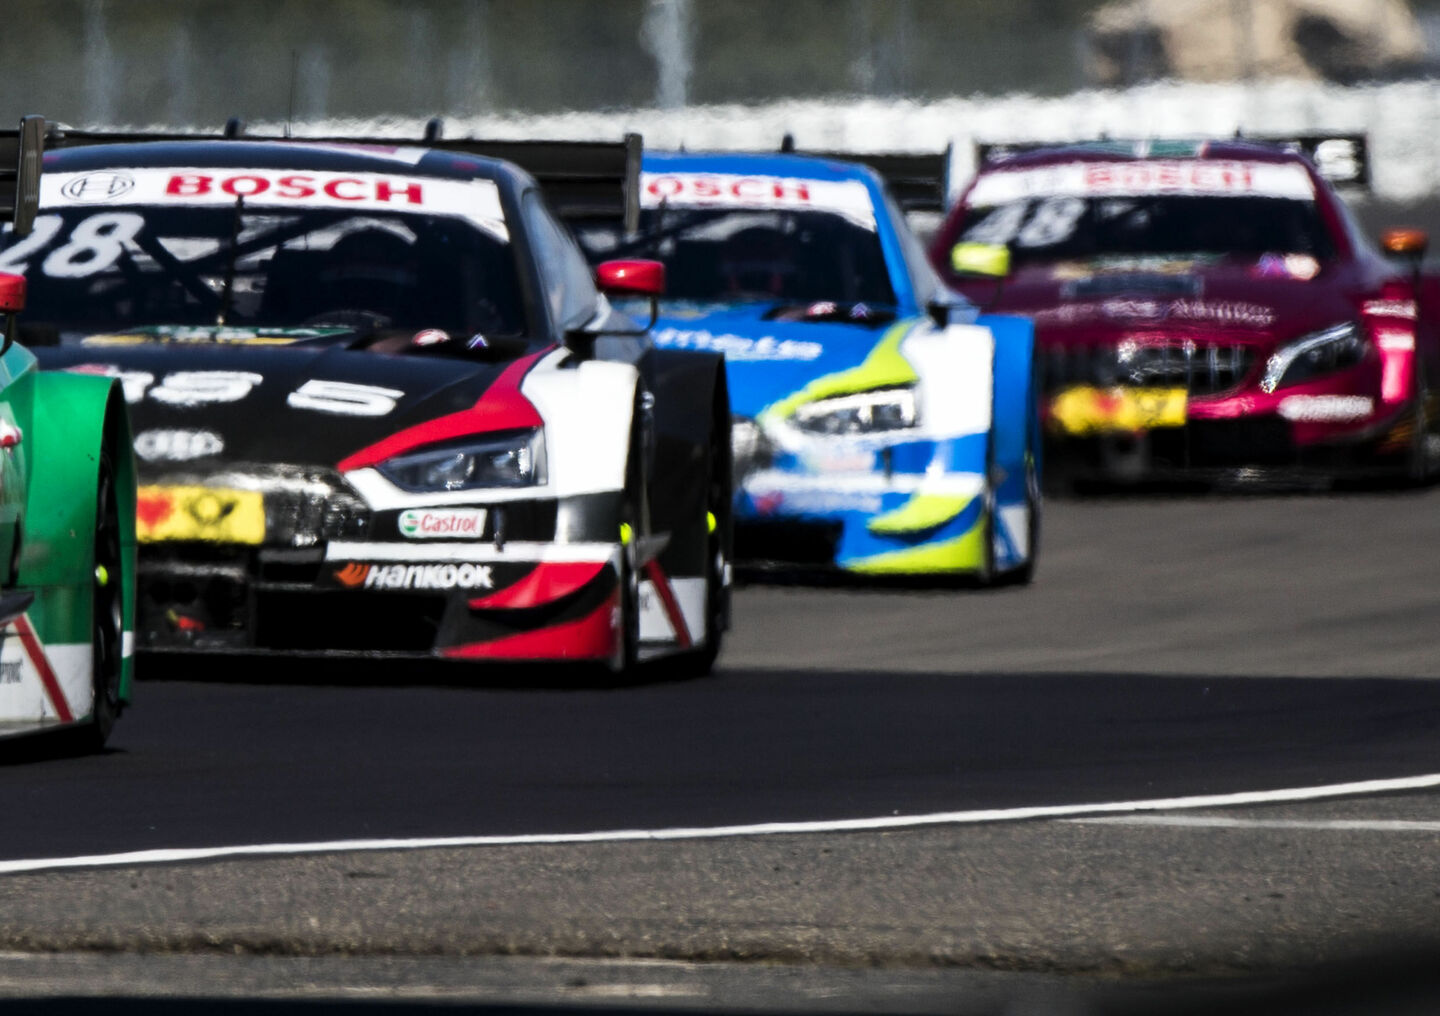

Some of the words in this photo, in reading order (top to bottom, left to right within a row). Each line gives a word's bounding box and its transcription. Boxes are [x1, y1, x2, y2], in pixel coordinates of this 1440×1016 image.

[165, 175, 423, 204] BOSCH
[646, 177, 810, 201] OSCH
[421, 513, 478, 534] Castrol
